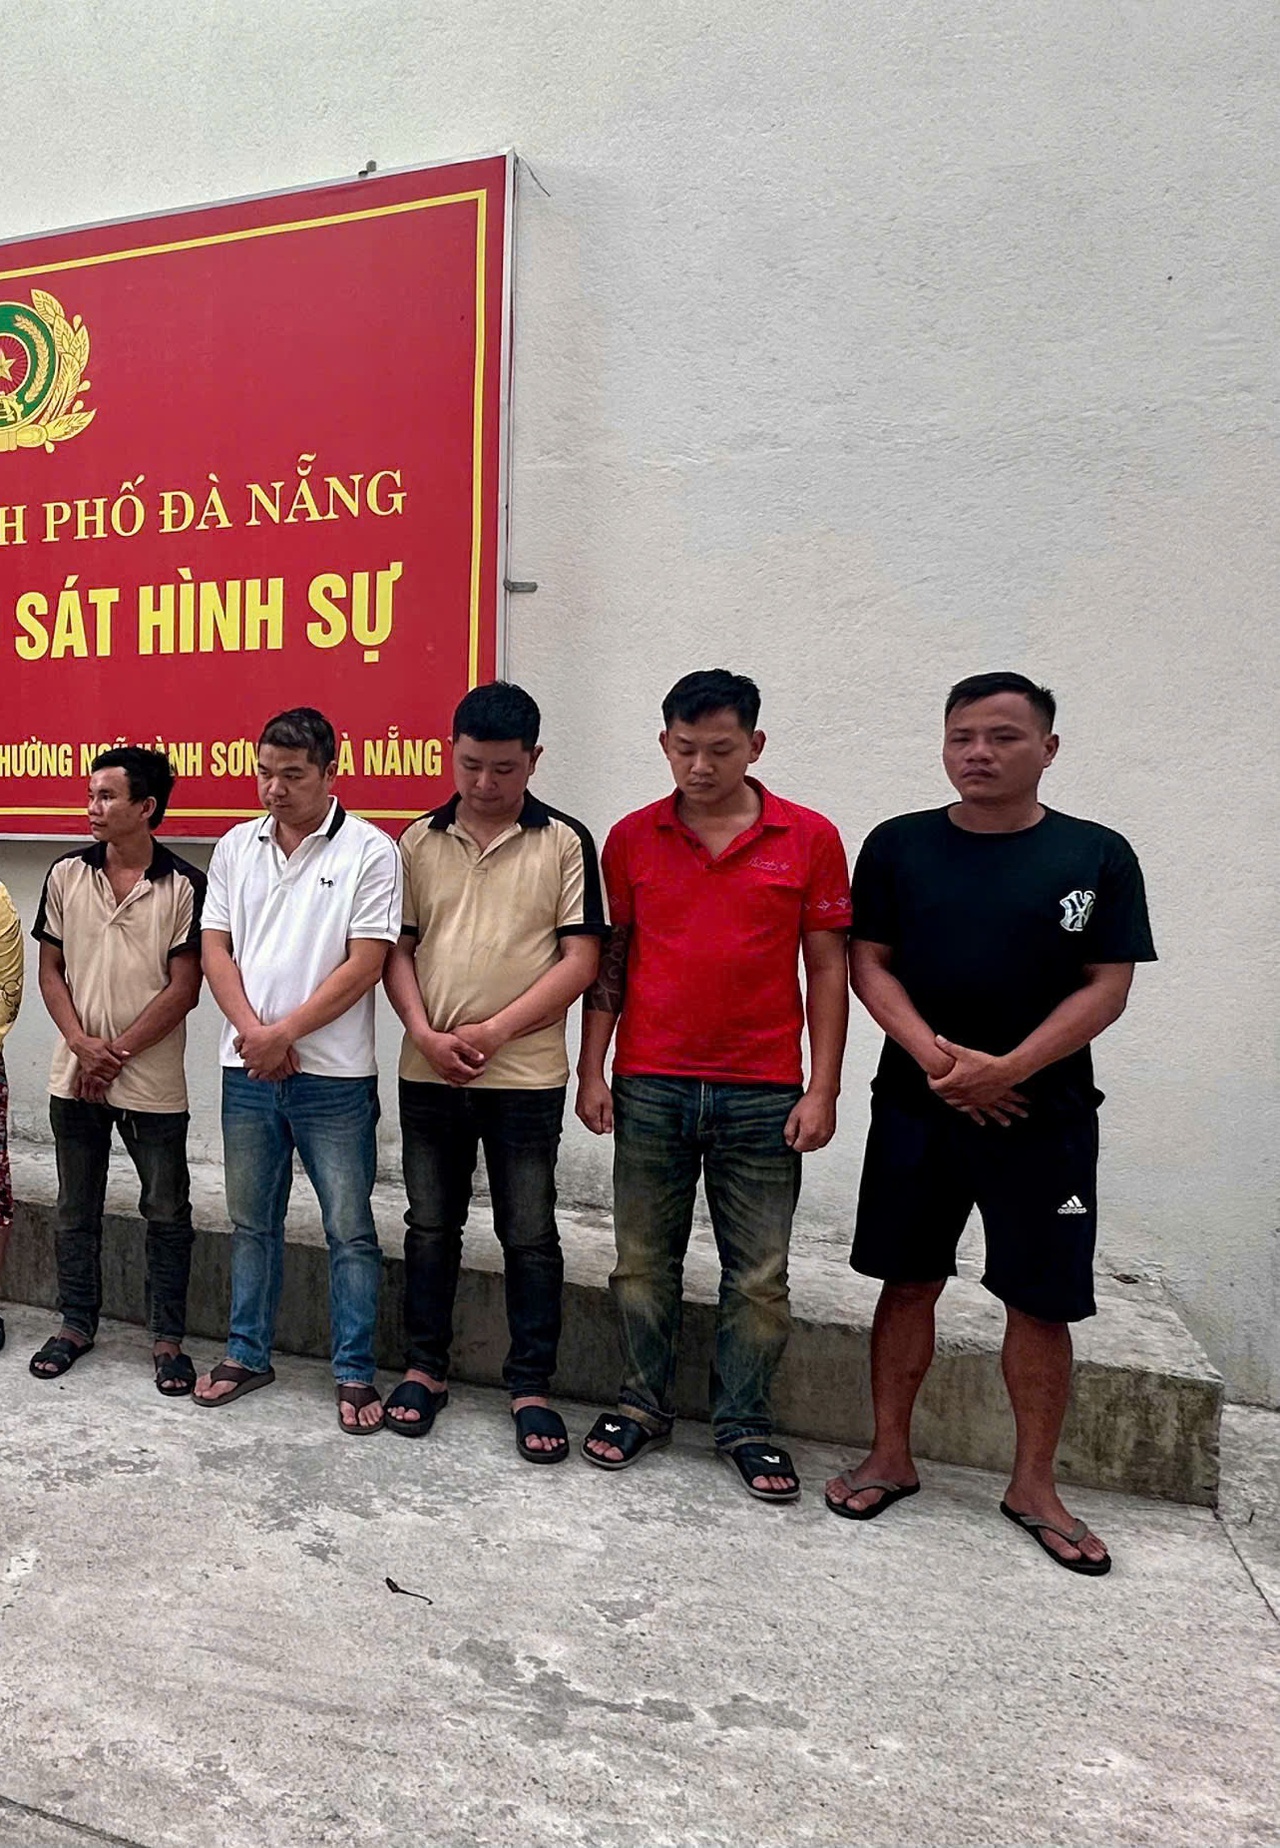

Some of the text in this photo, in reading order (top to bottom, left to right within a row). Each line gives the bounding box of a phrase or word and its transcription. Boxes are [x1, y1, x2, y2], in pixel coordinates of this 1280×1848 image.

[41, 474, 145, 542] PHỐ
[158, 473, 233, 533] ĐÀ
[245, 452, 408, 527] NẴNG
[14, 574, 120, 661] SÁT
[138, 567, 284, 655] HÌNH
[305, 561, 404, 664] SỰ
[136, 735, 202, 777] NH
[336, 732, 356, 776] À
[364, 725, 443, 777] NẴNG
